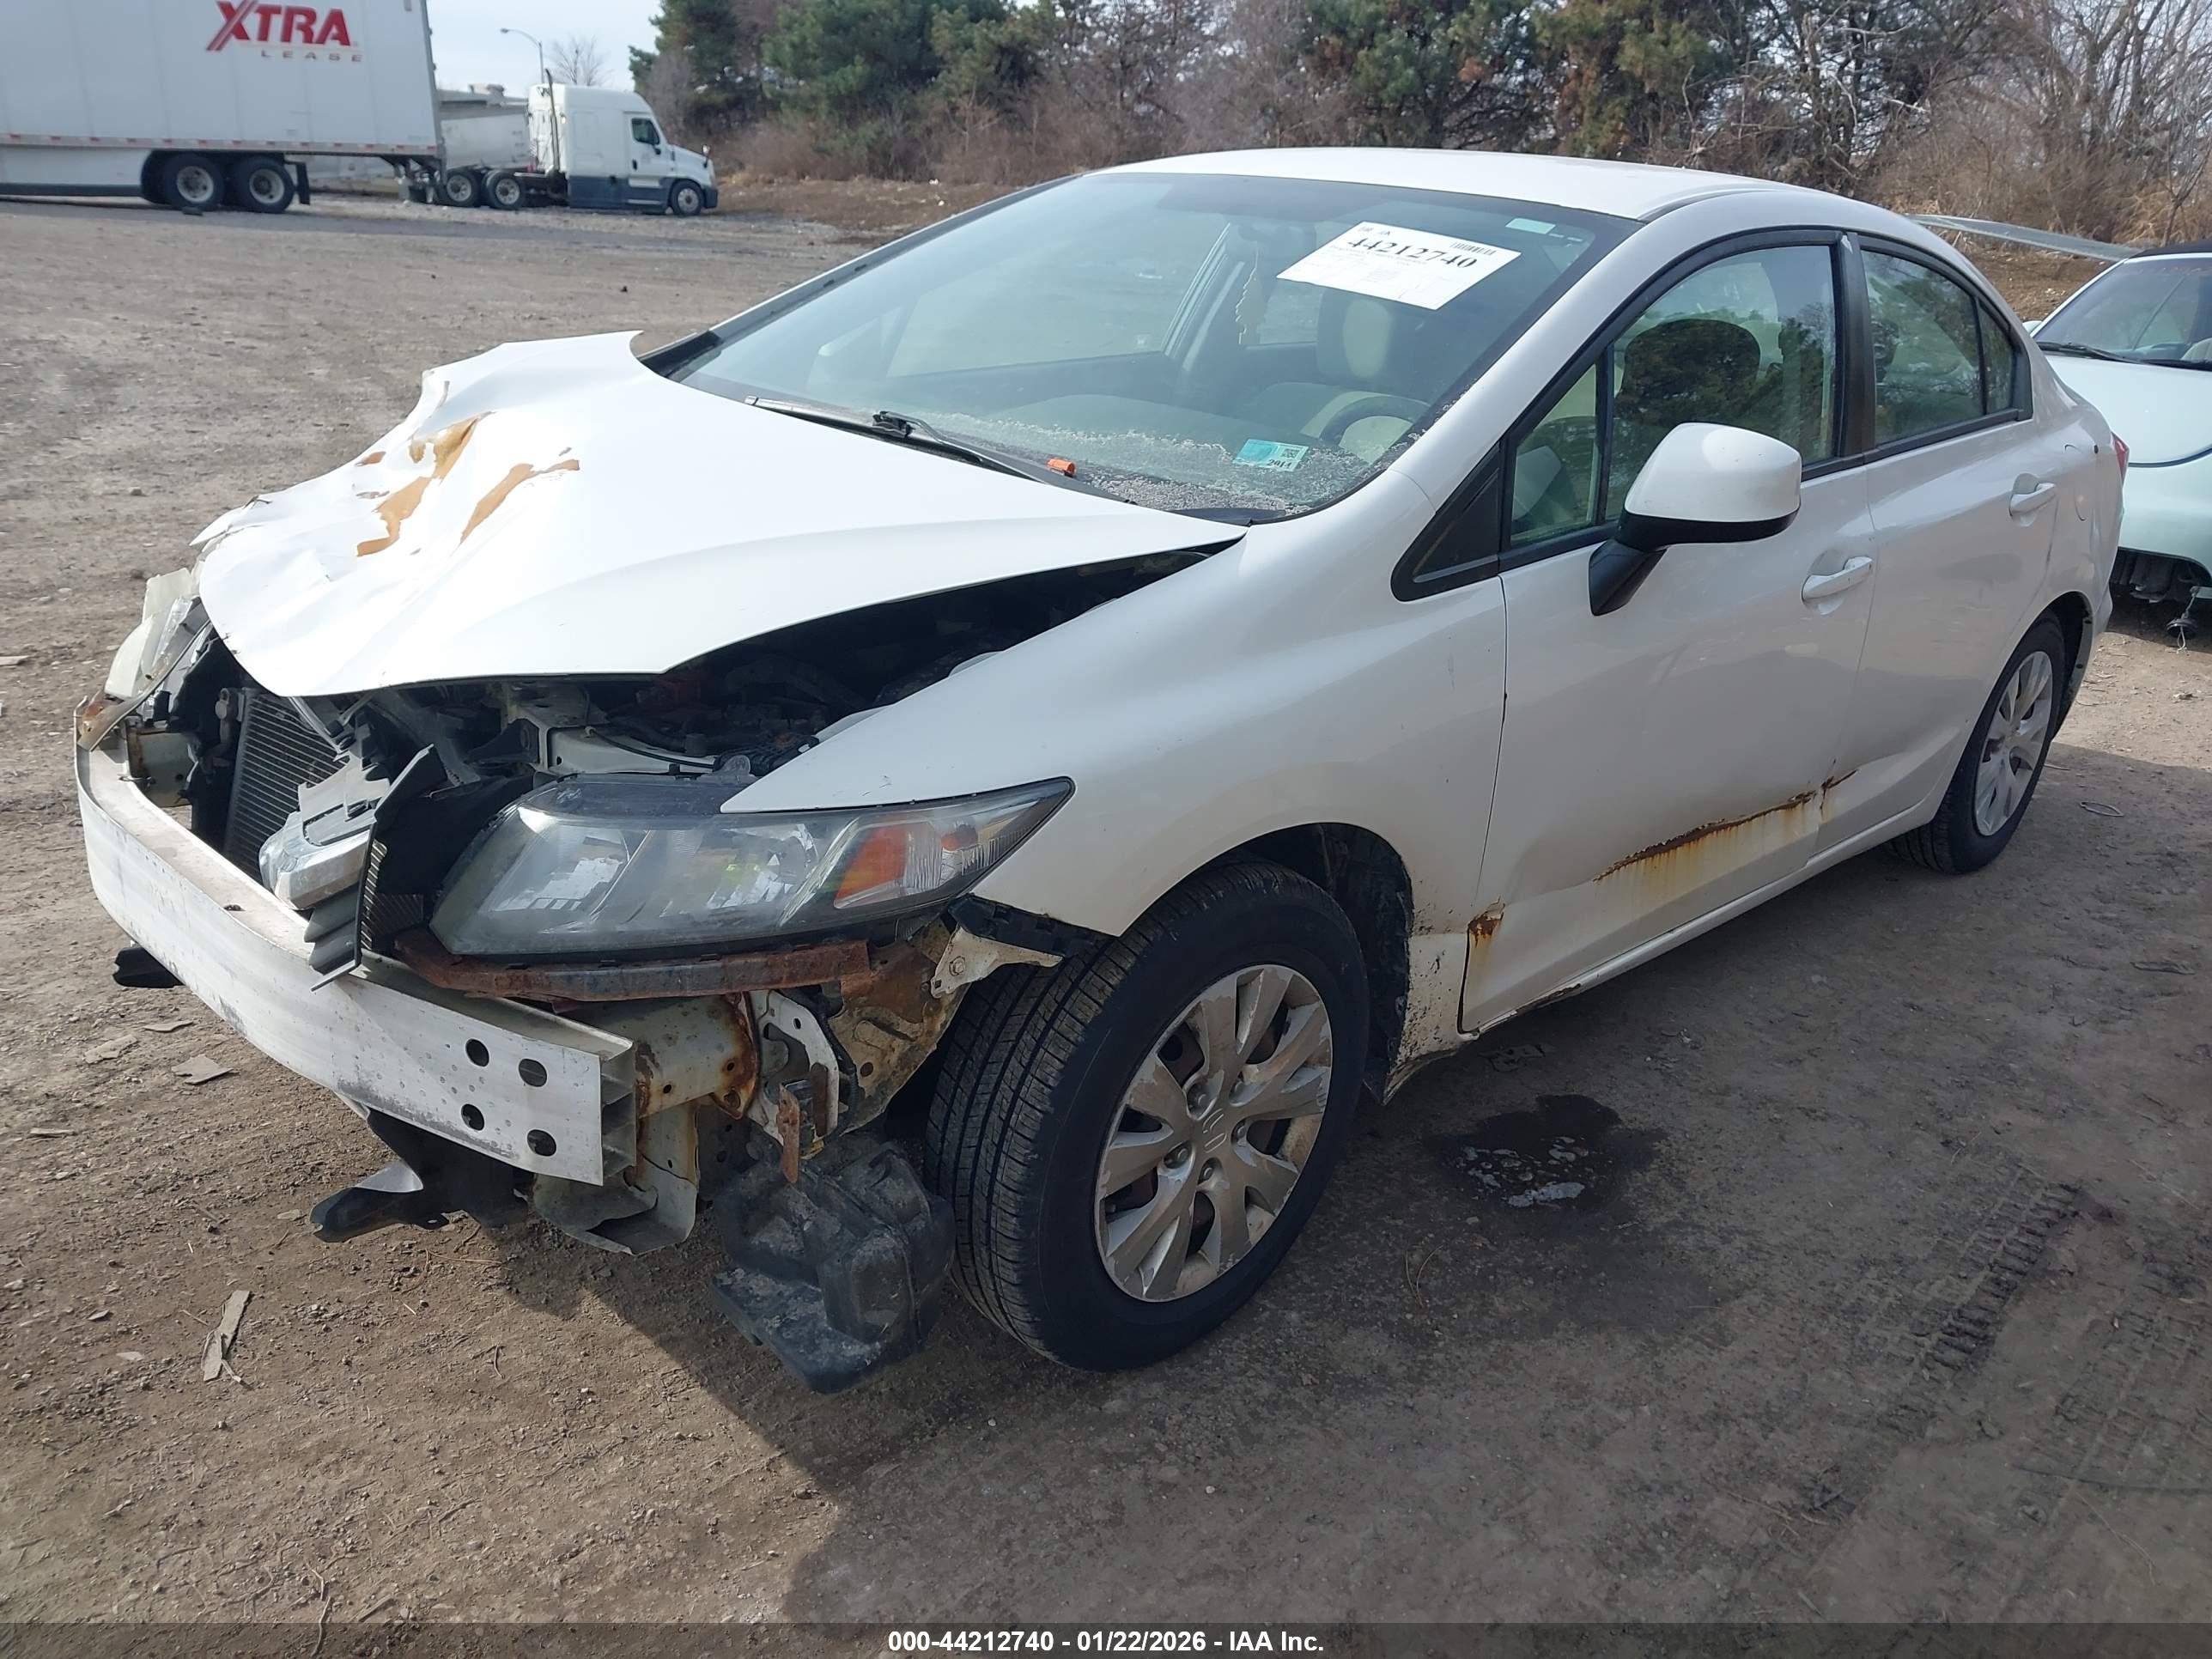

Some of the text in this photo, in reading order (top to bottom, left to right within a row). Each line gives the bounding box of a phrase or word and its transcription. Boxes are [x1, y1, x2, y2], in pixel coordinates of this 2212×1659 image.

[205, 0, 351, 51] XTRA
[260, 50, 363, 63] LEASE
[1347, 237, 1478, 268] 44212740
